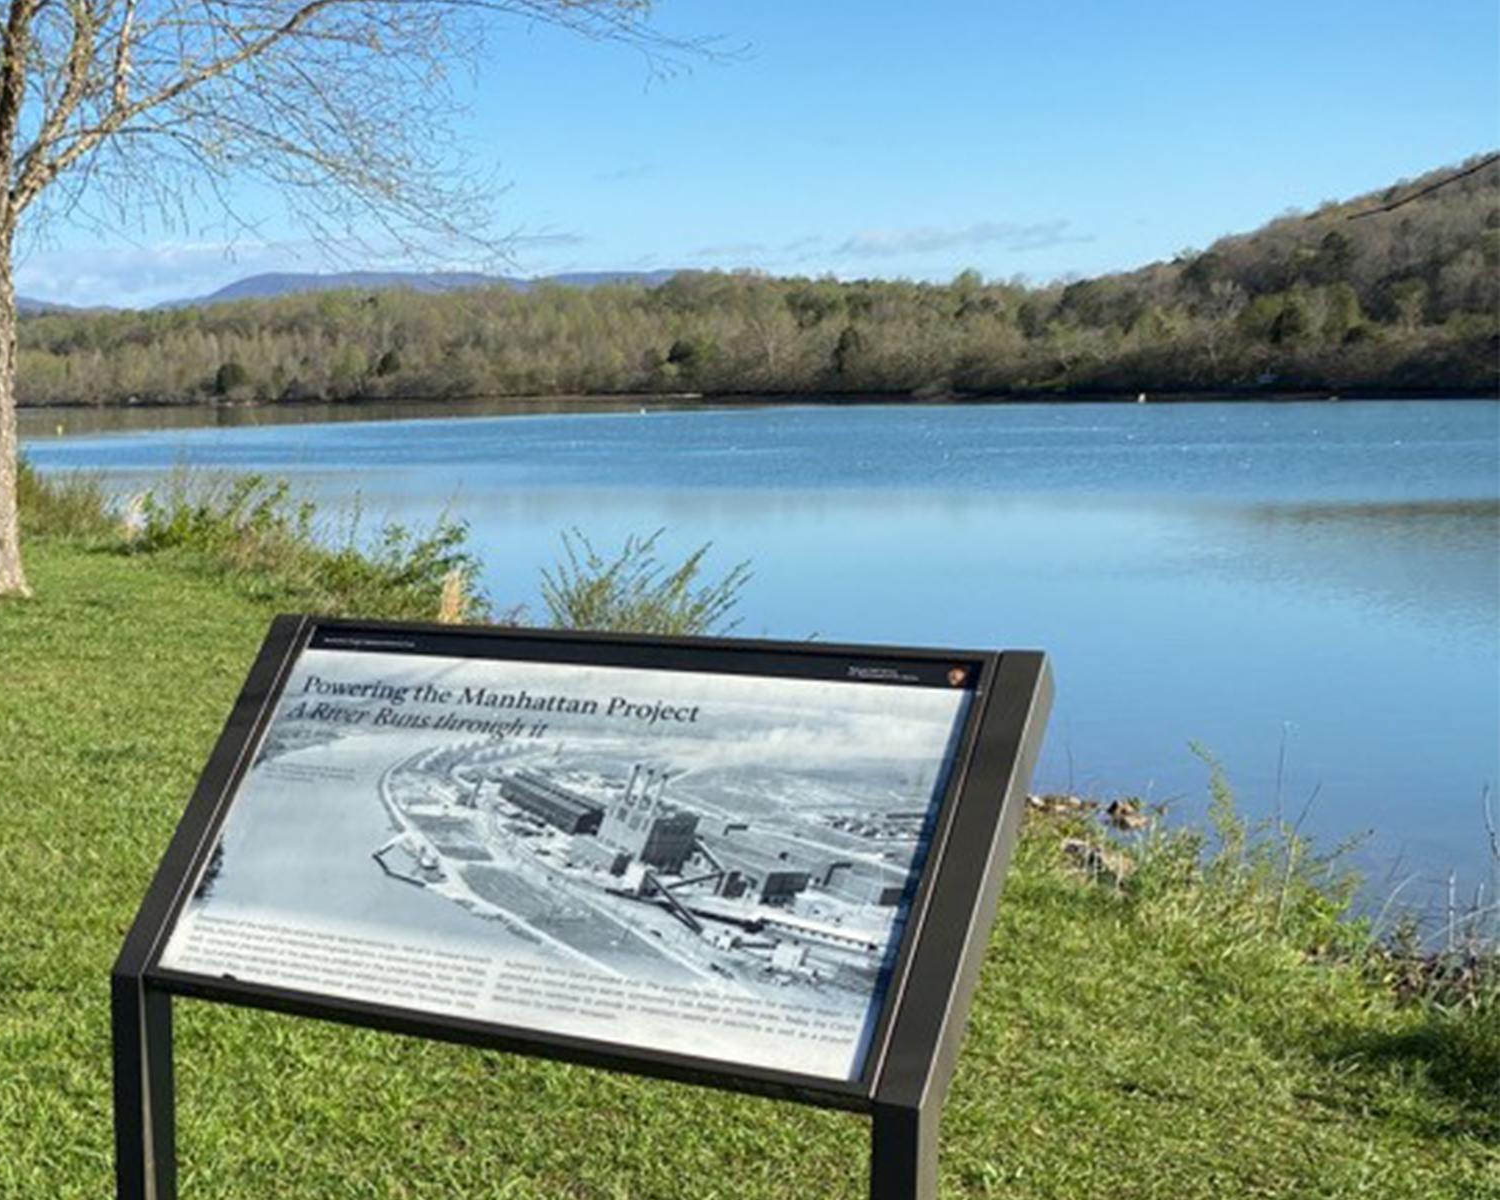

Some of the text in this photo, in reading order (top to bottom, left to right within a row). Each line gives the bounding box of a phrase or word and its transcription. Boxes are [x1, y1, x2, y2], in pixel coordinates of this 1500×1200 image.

[286, 702, 548, 740] A River Runs through it
[302, 675, 699, 725] Powering the Manhattan Project
